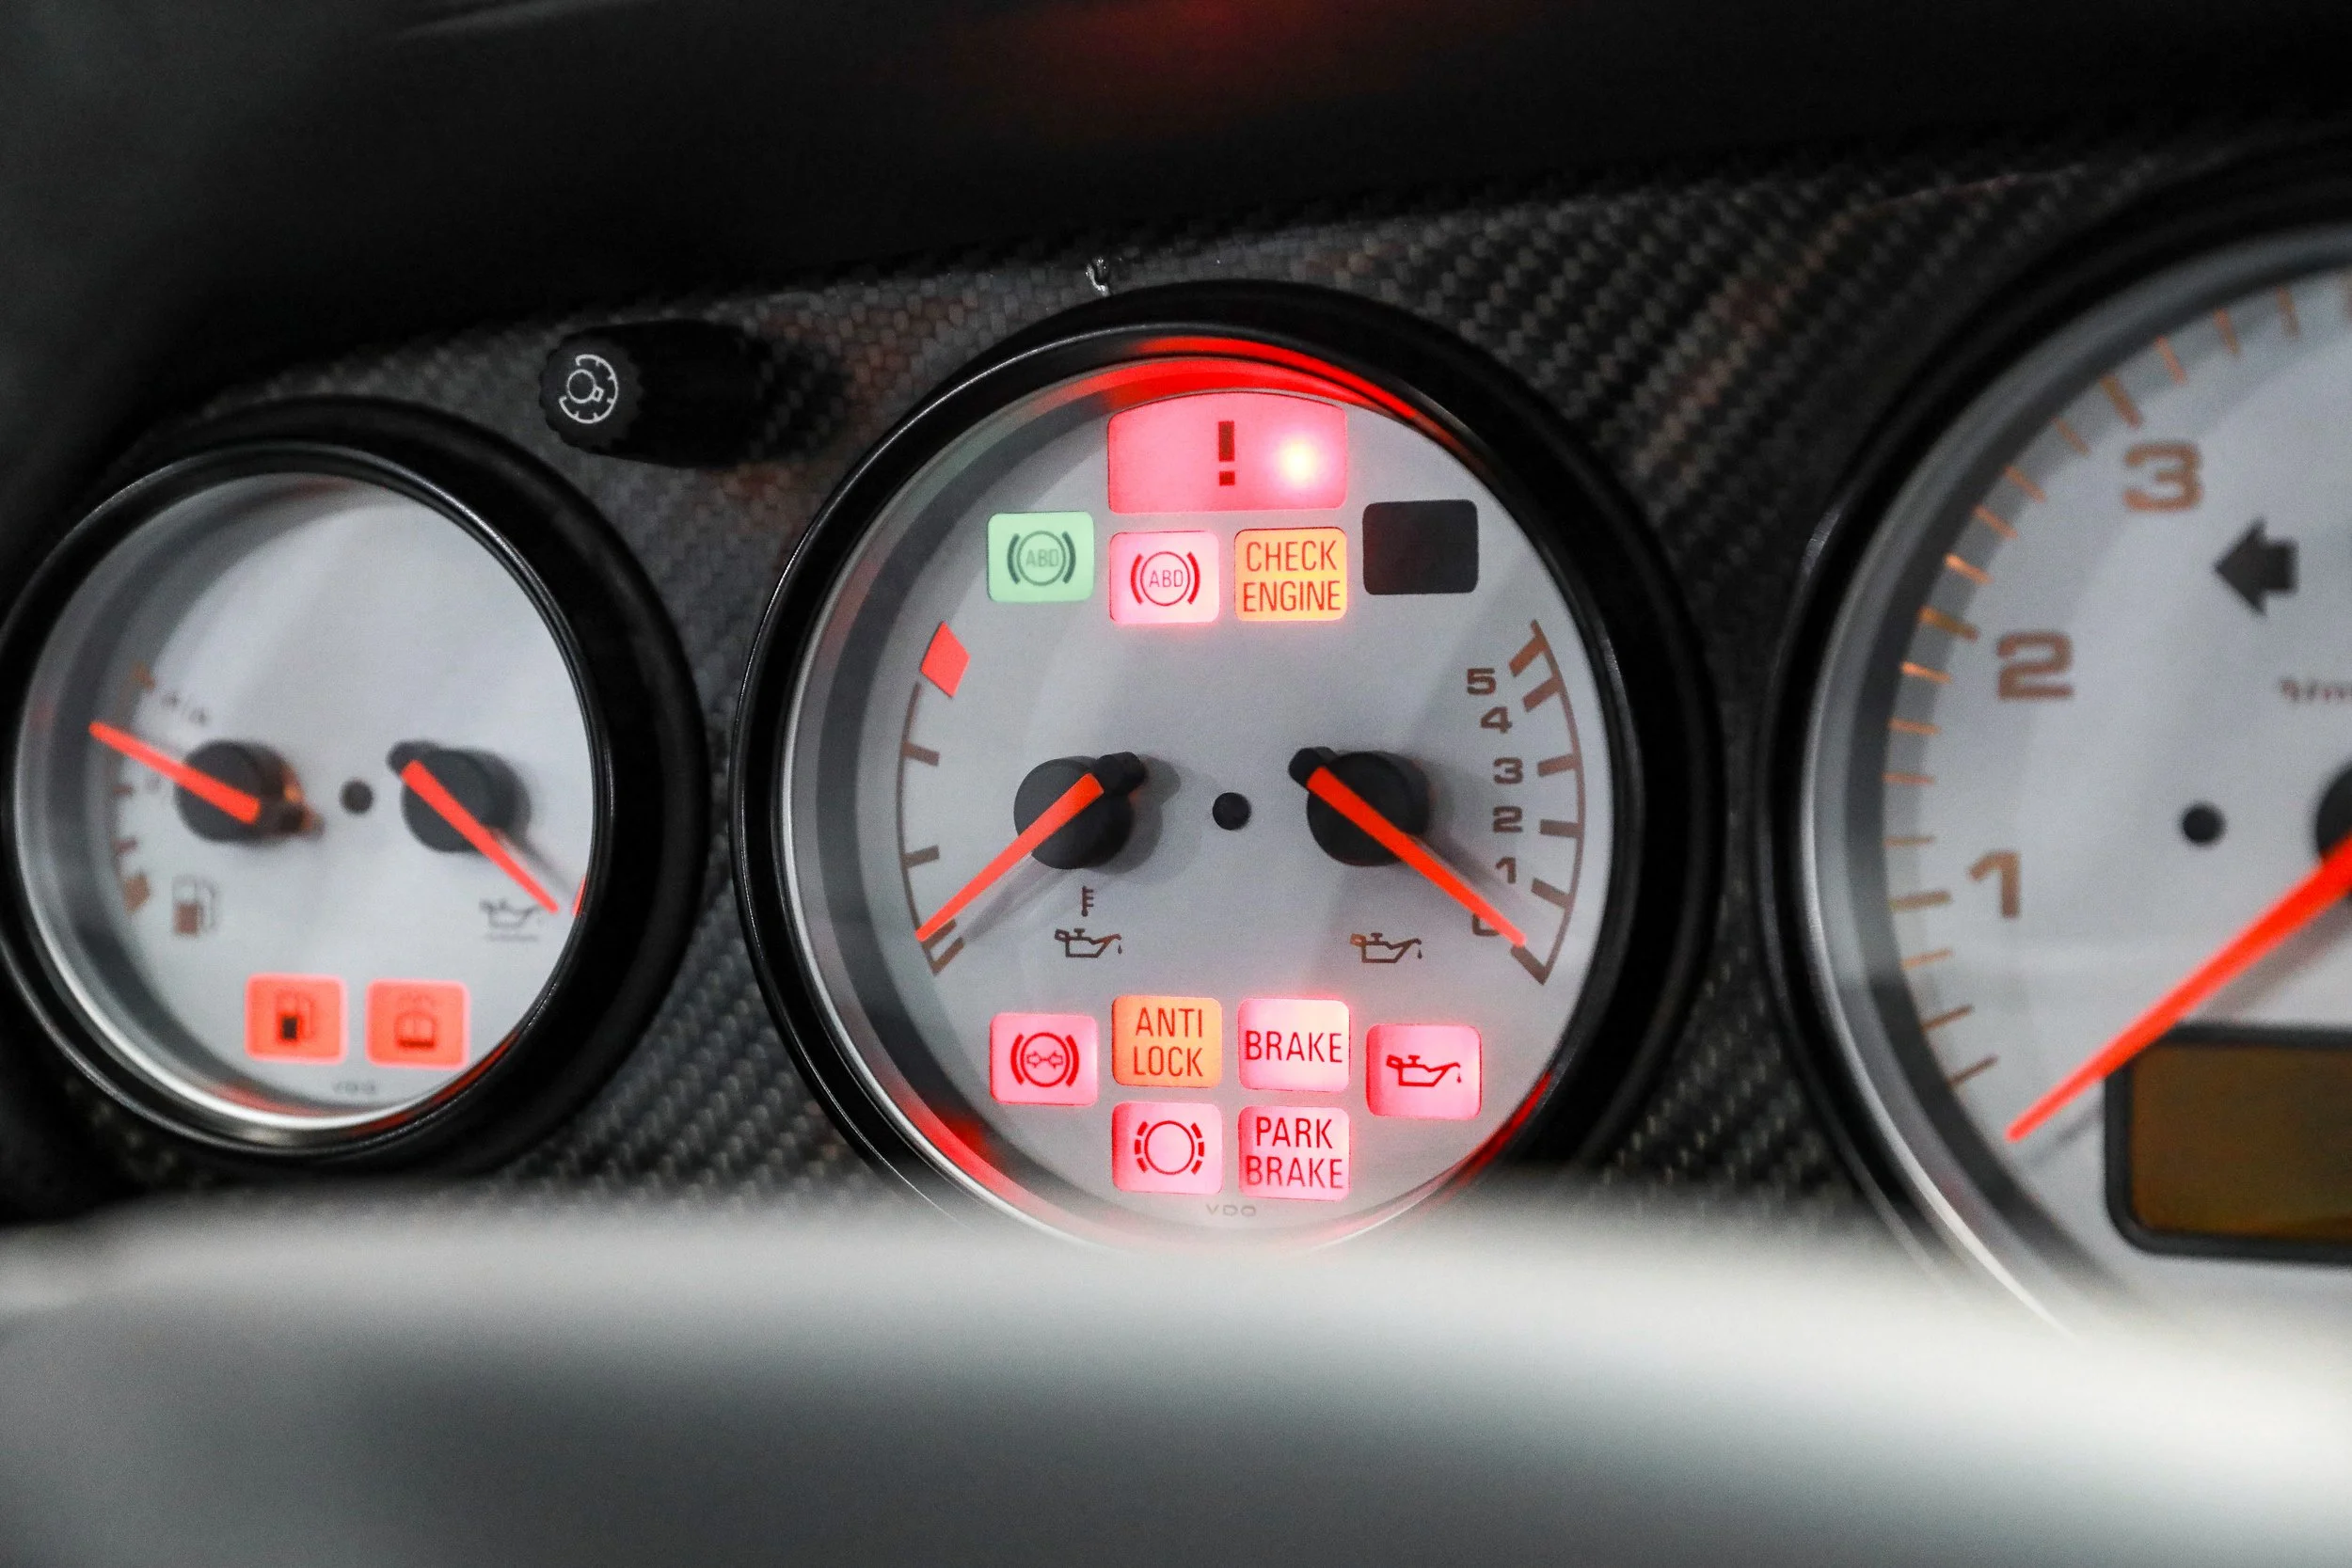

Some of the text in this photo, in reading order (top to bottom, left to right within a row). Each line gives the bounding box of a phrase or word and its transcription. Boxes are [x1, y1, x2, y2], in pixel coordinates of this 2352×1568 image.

[2123, 441, 2203, 514] 3
[1025, 547, 1059, 568] ABD
[1246, 540, 1338, 573] CHECK
[1148, 569, 1184, 588] ABD
[1243, 580, 1342, 612] ENGINE
[1467, 667, 1497, 695] 5
[1996, 630, 2074, 702] 2
[1480, 705, 1513, 734] 4
[1493, 757, 1523, 784] 3
[1493, 805, 1523, 833] 2
[1495, 856, 1517, 884] 1
[1968, 850, 2020, 919] 1
[1135, 1006, 1203, 1038] ANTI
[1133, 1045, 1204, 1078] LOCK
[1245, 1029, 1343, 1064] BRAKE
[1256, 1116, 1333, 1149] PARK
[1245, 1156, 1344, 1190] BRAKE
